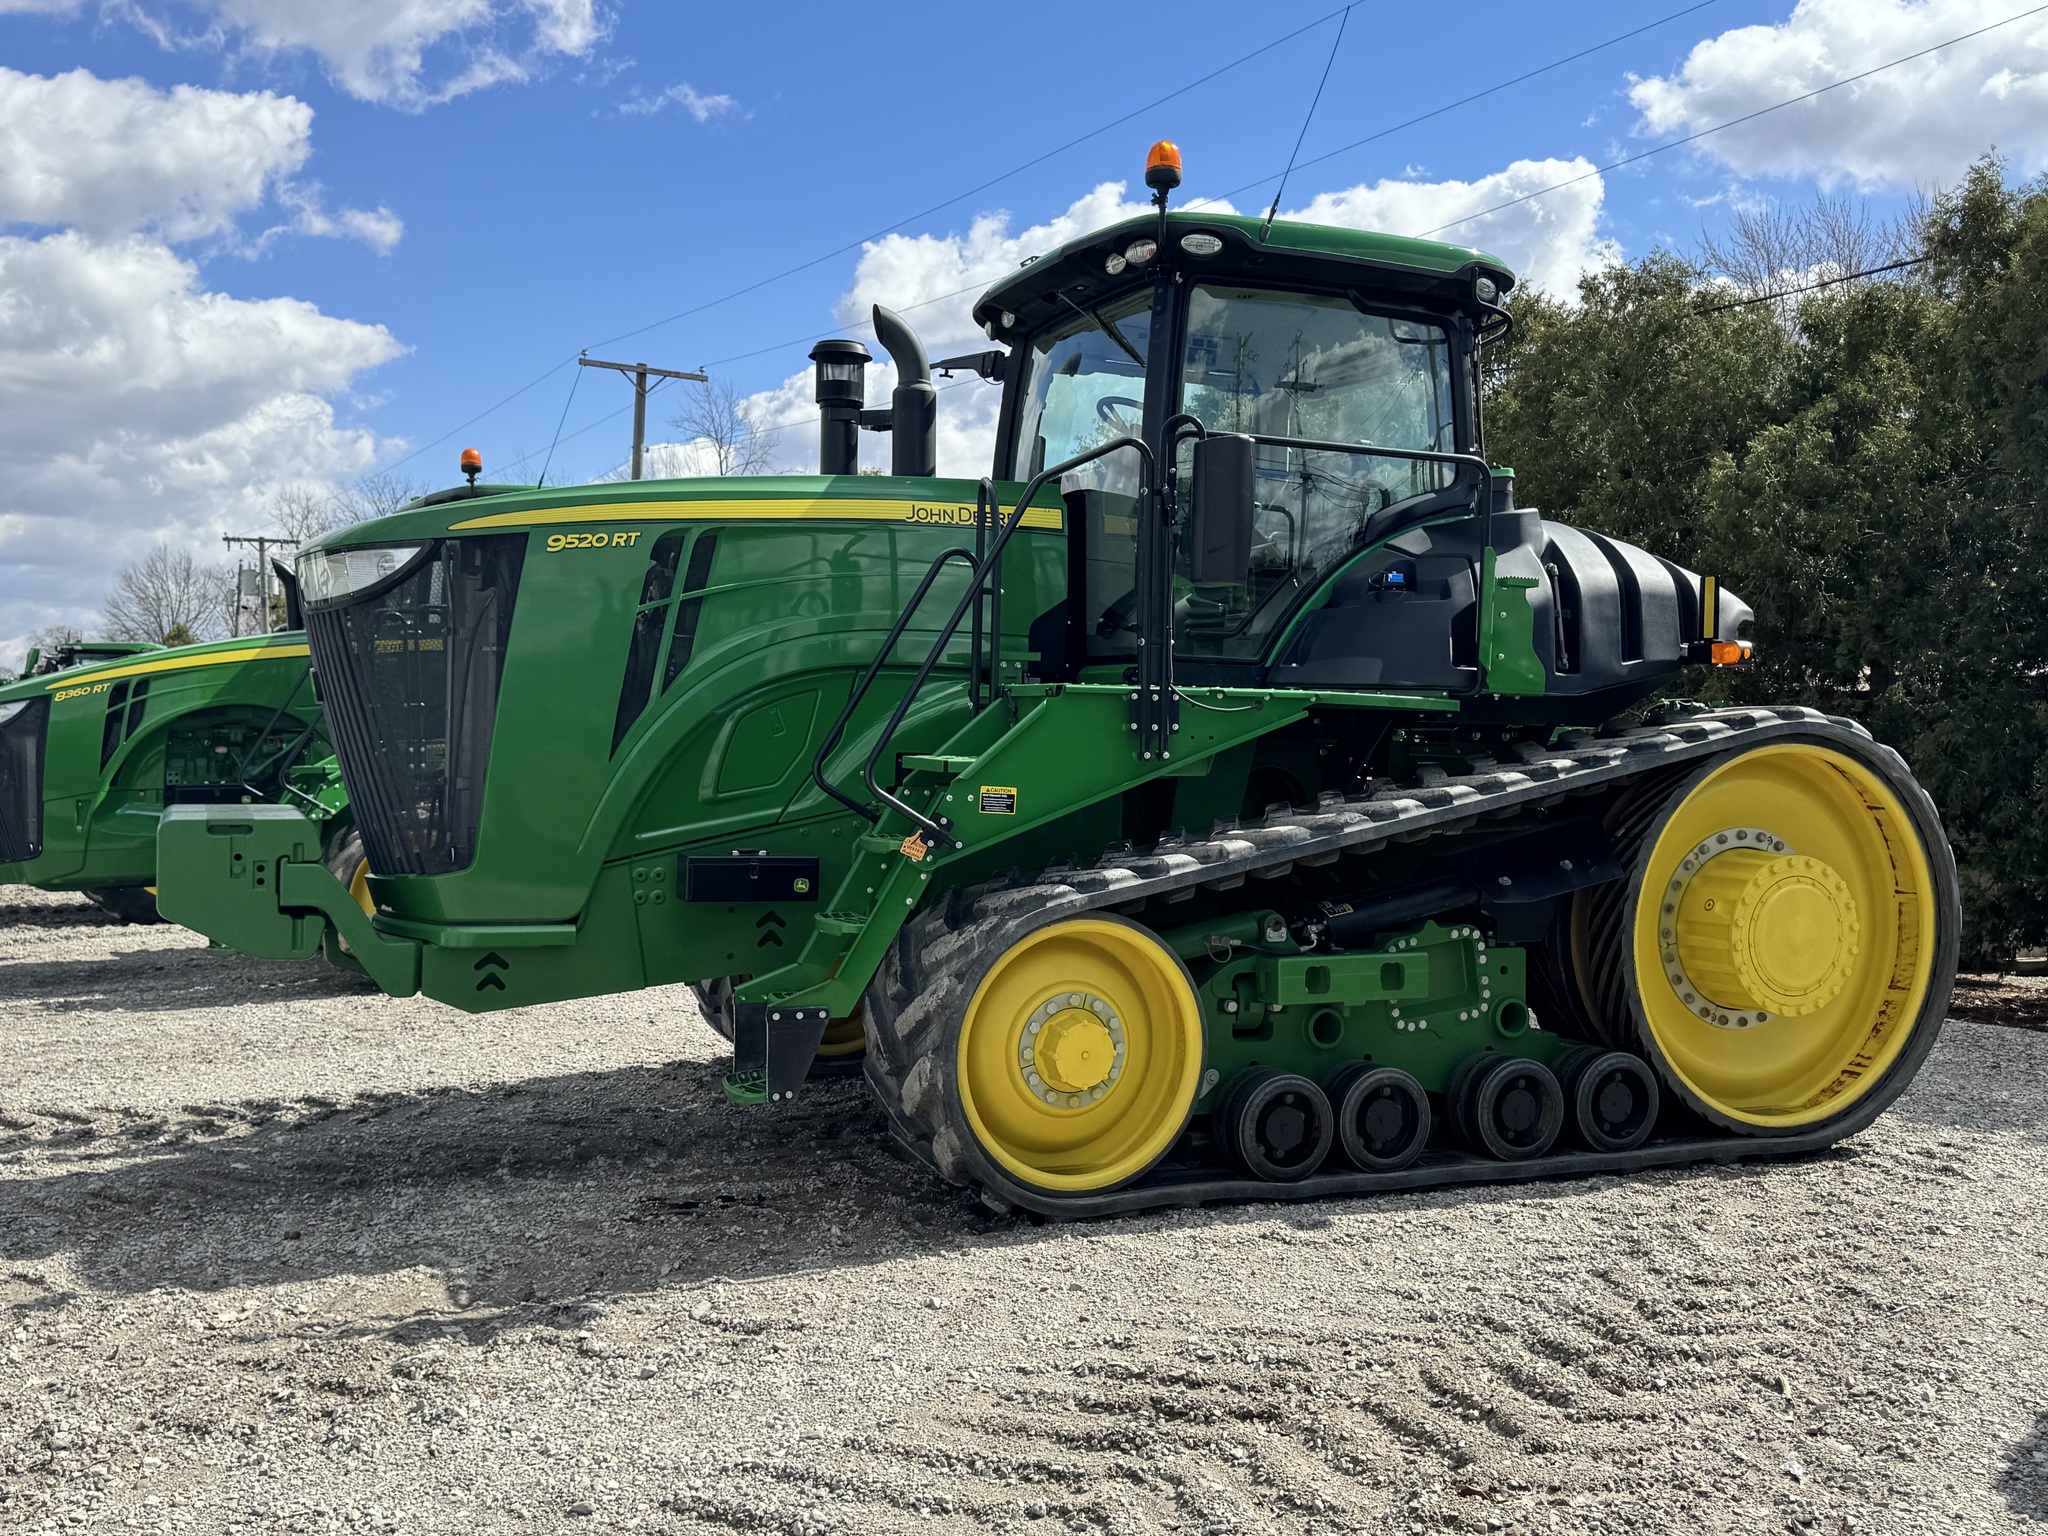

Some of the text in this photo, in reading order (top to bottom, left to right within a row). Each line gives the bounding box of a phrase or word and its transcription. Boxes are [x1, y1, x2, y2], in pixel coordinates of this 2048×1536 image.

[905, 504, 955, 521] JOHN
[546, 531, 641, 552] 9520 RT
[54, 683, 111, 701] 8360 RT
